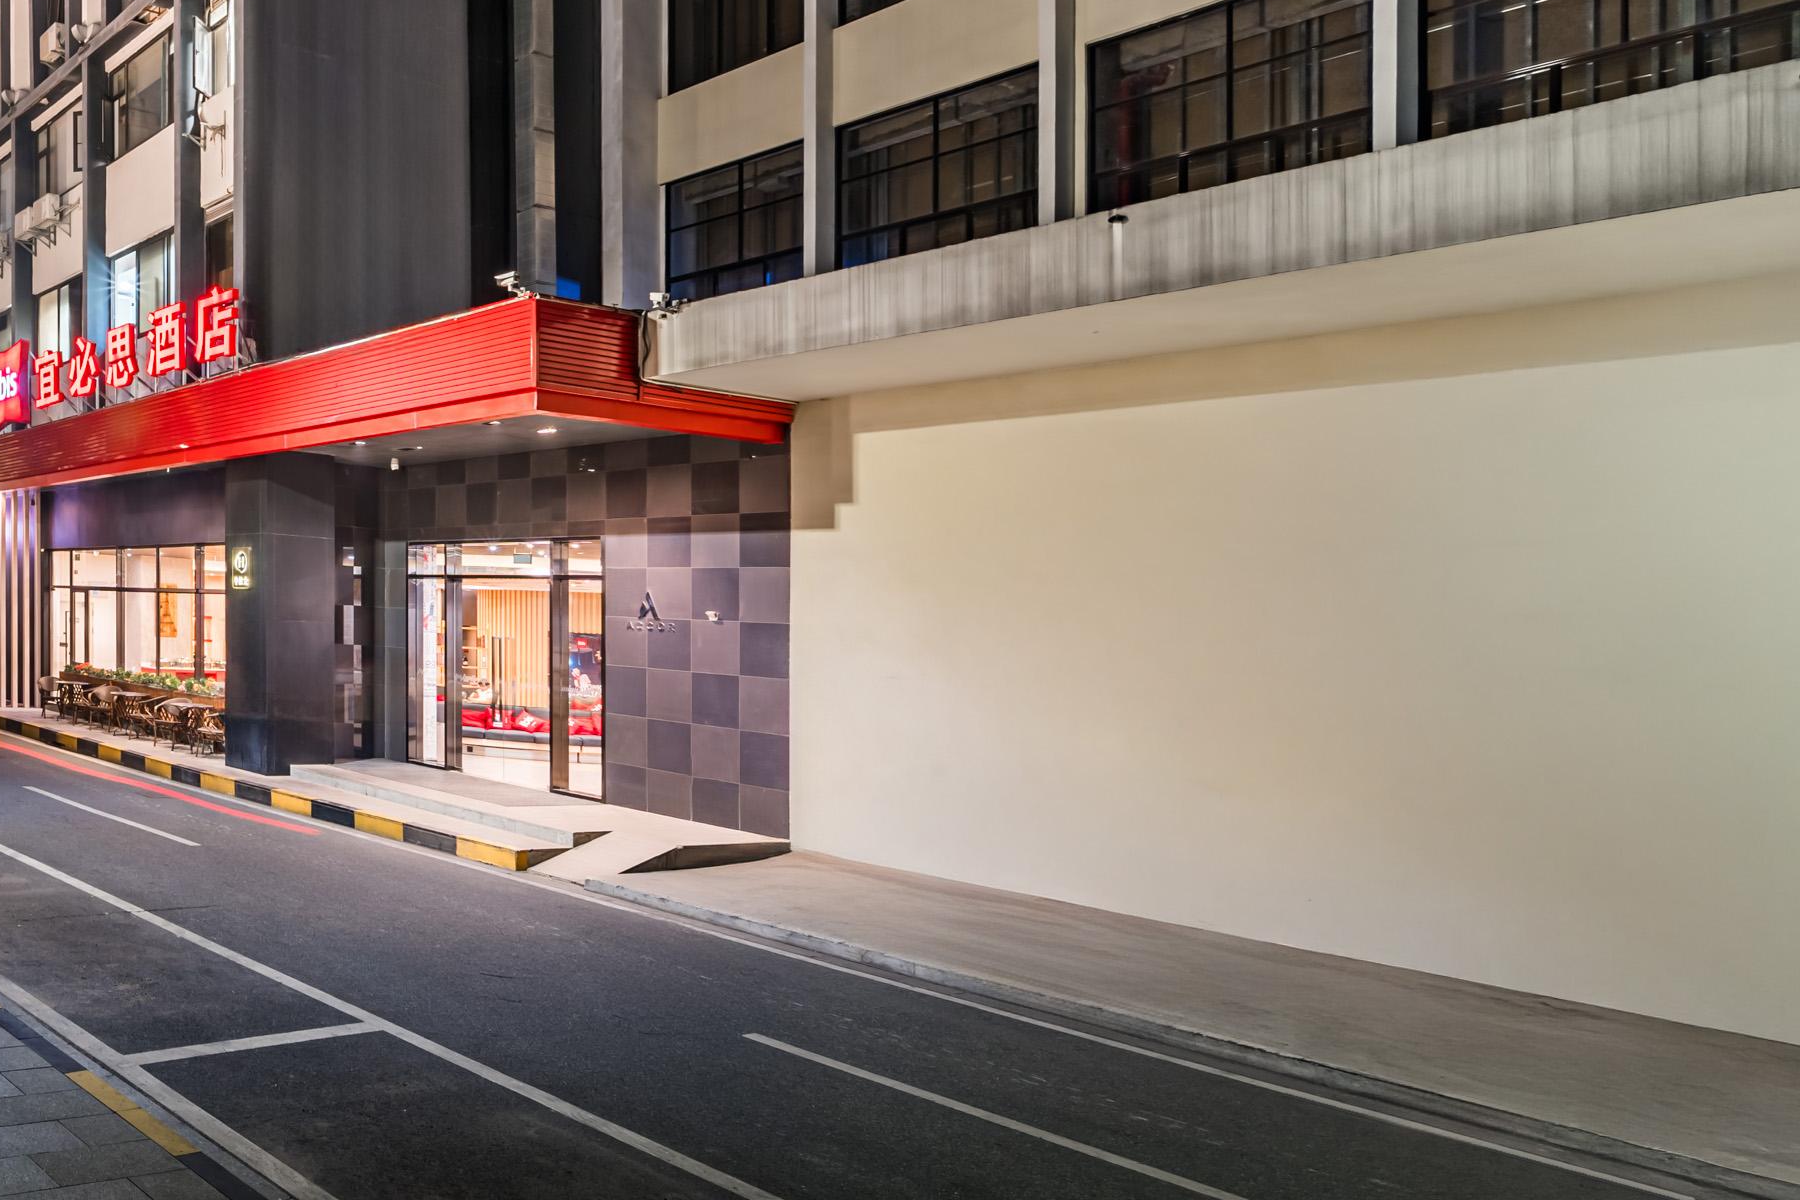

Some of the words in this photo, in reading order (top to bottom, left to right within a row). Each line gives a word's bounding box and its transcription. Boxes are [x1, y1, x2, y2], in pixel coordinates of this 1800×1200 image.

[34, 284, 240, 409] 宜必思酒店
[626, 620, 677, 633] ACCOR
